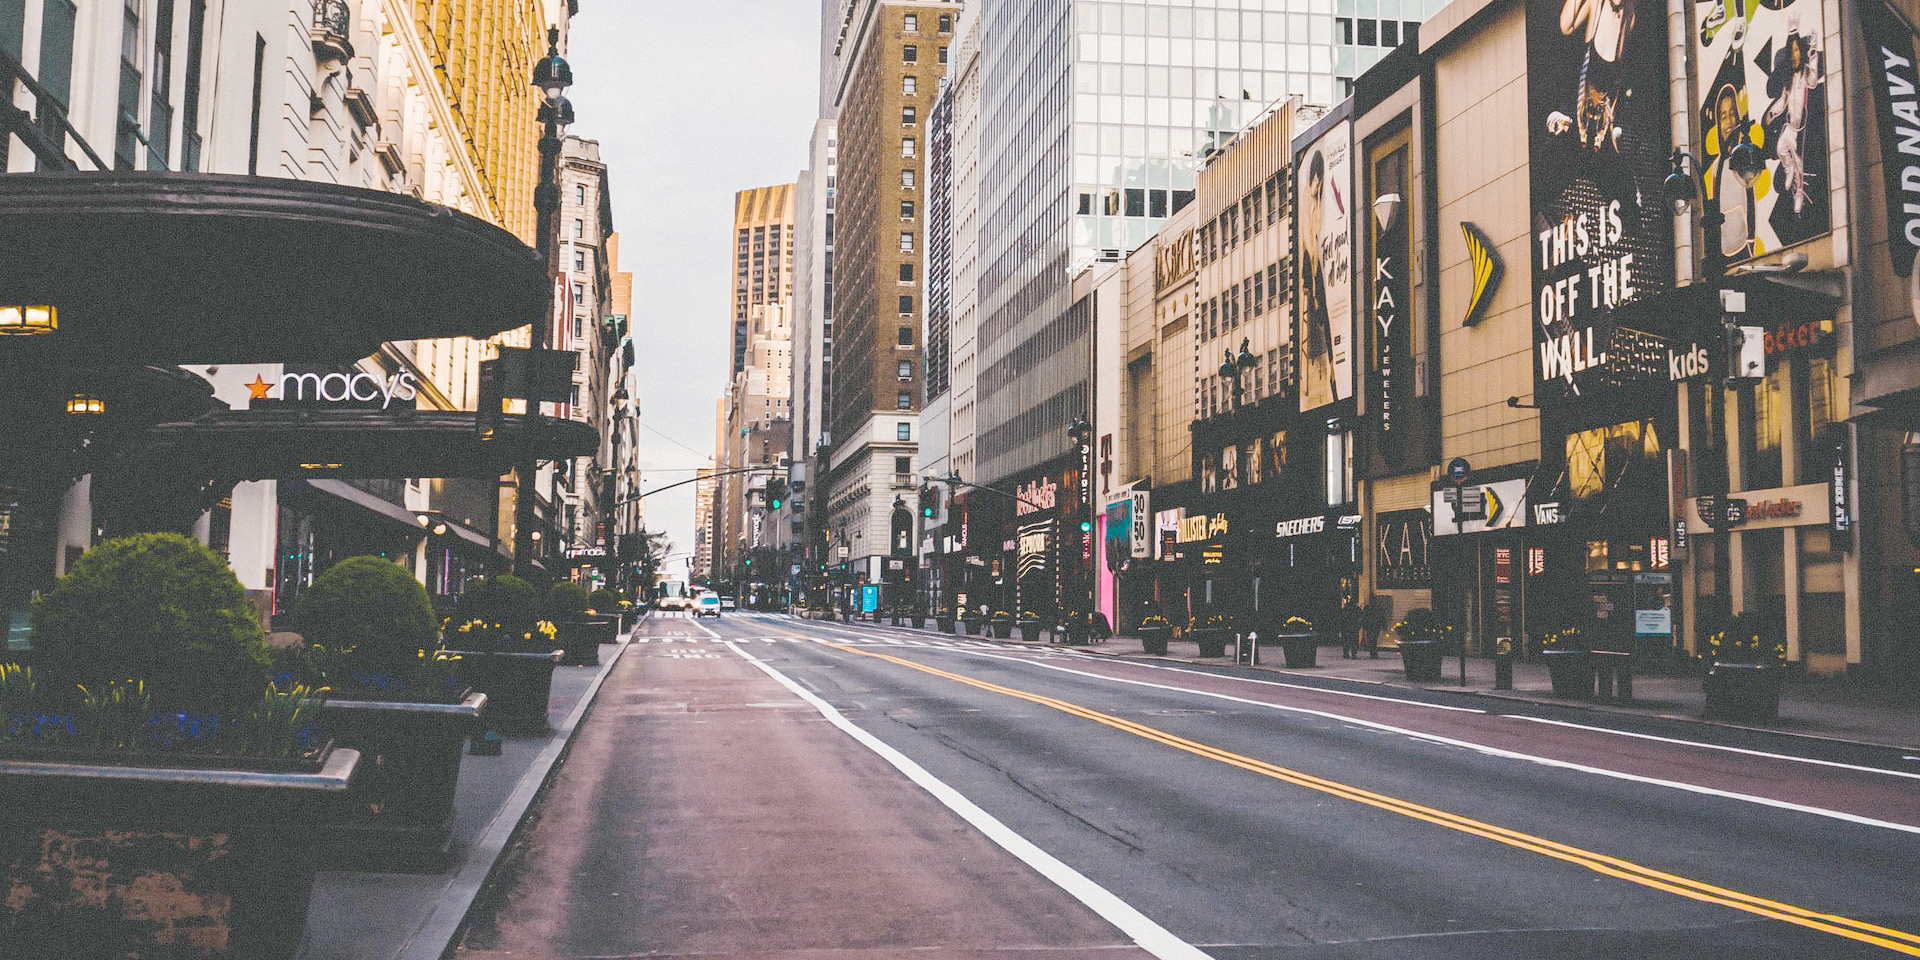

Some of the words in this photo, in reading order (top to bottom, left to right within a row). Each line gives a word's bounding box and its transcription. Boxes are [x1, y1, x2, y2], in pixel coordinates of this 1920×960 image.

[1881, 45, 1920, 156] NAVY
[1539, 212, 1589, 271] THIS
[1599, 199, 1623, 248] IS
[1376, 256, 1395, 338] KAY
[1541, 273, 1581, 326] OFF
[1588, 253, 1634, 309] THE
[1540, 326, 1607, 381] WALL.
[1763, 317, 1818, 355] ocker
[1668, 342, 1709, 381] kids
[1382, 344, 1391, 432] JEWELERS
[1134, 493, 1145, 514] 30
[1534, 502, 1559, 525] VANS
[1134, 521, 1145, 541] 50
[1276, 515, 1325, 538] SKECHERS
[1380, 521, 1428, 566] KAY
[1676, 521, 1686, 548] kids
[1535, 549, 1544, 574] VANS
[1657, 538, 1669, 568] VANS
